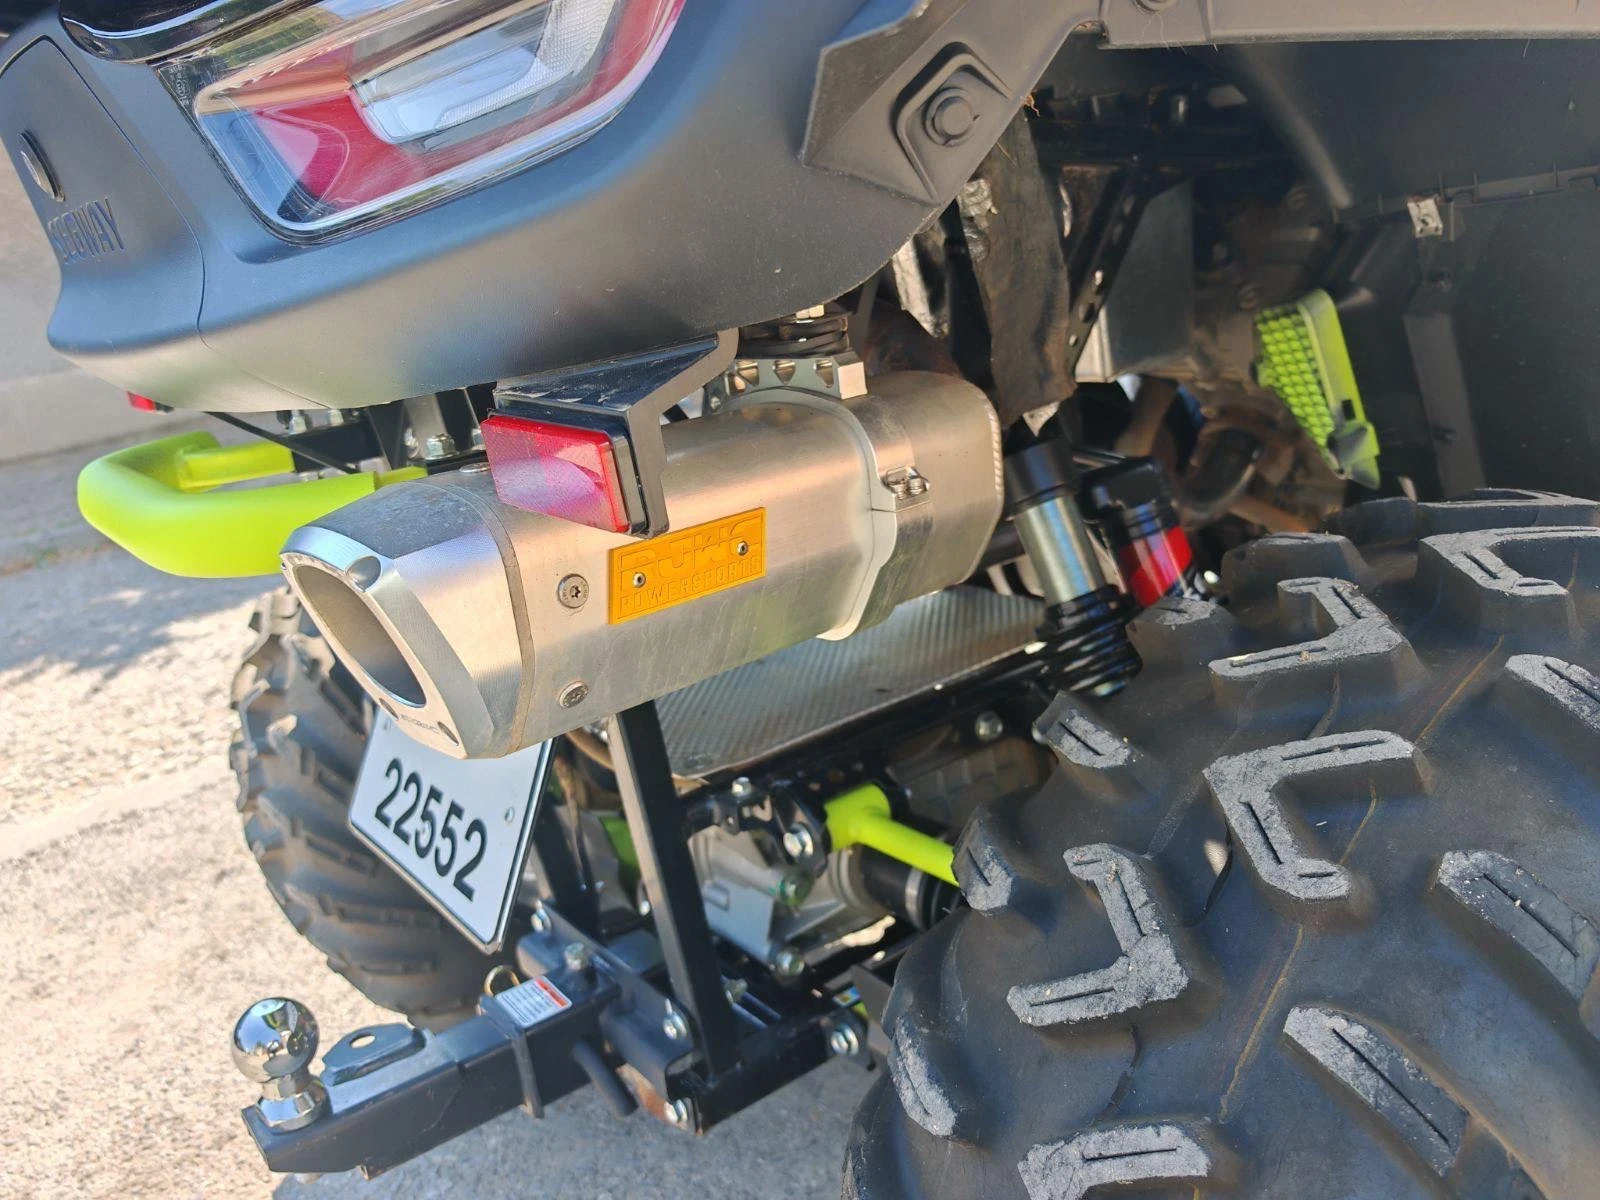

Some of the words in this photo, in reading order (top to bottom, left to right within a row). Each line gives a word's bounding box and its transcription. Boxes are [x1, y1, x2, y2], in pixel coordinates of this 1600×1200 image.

[48, 198, 125, 264] SEGWAY
[619, 556, 761, 616] POWERSPORTS
[374, 757, 488, 902] 22552
